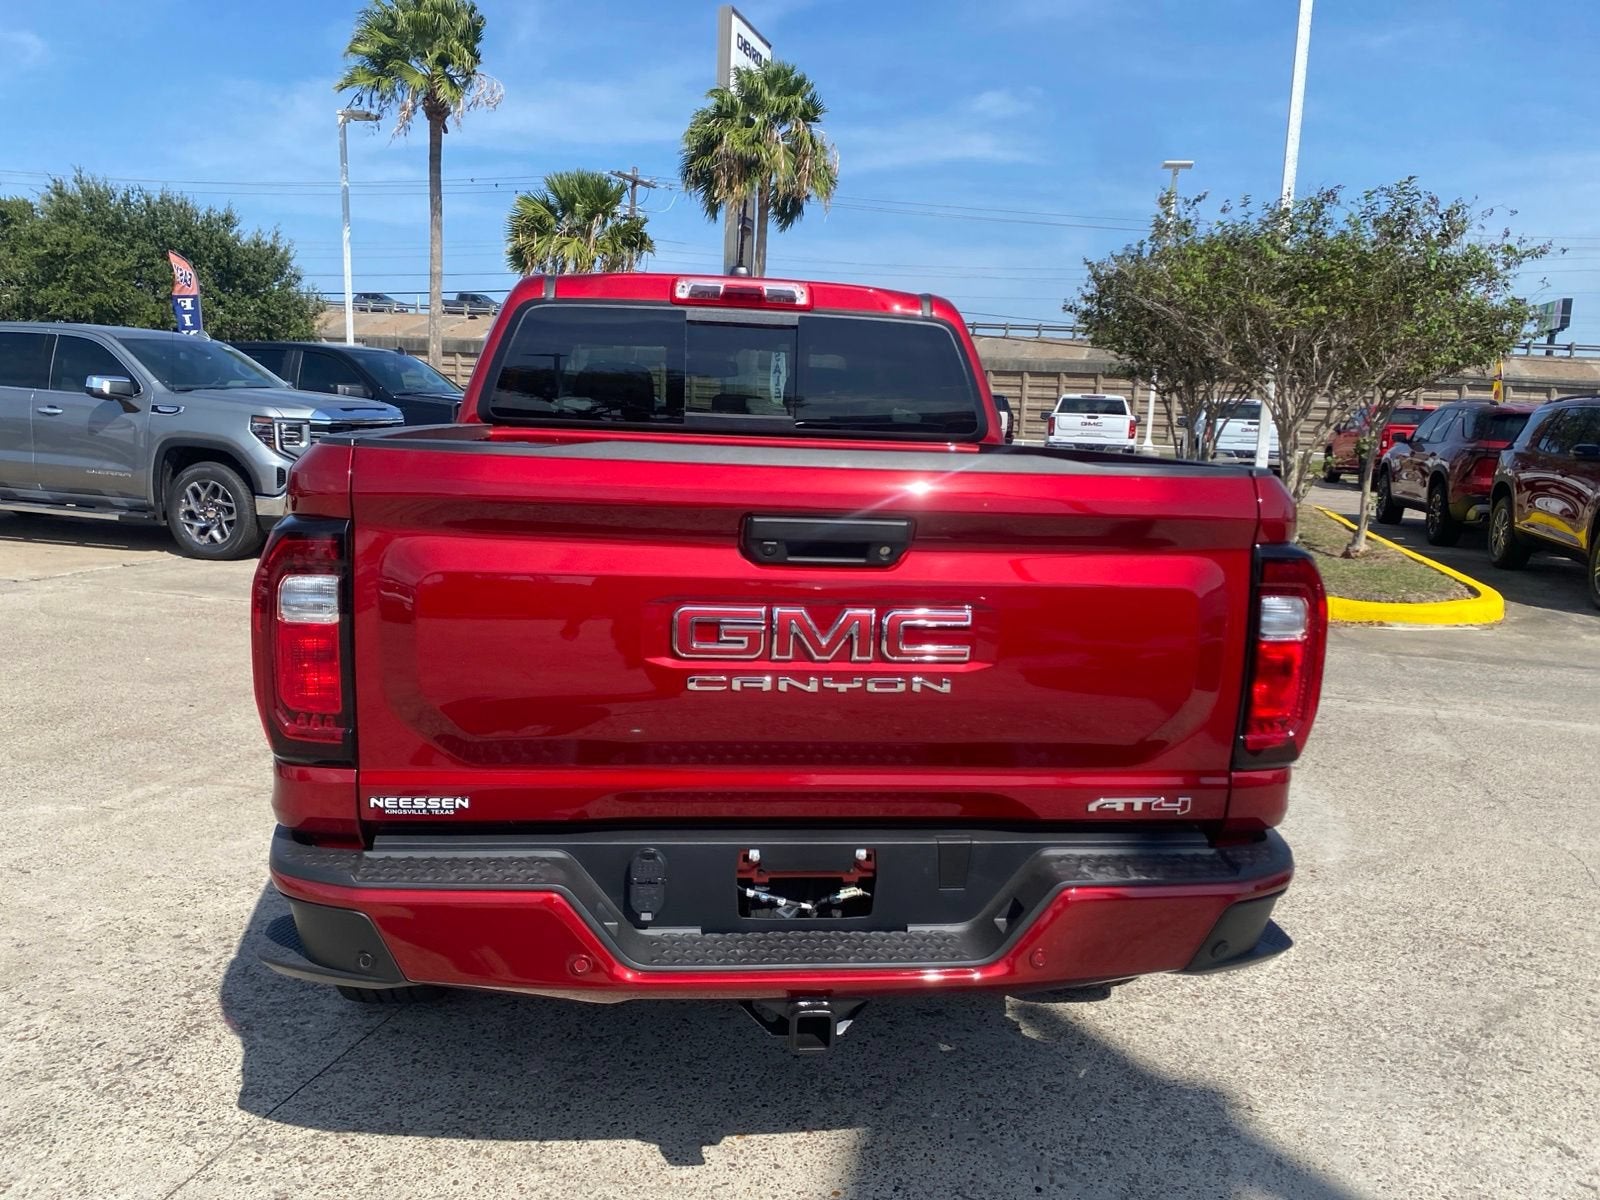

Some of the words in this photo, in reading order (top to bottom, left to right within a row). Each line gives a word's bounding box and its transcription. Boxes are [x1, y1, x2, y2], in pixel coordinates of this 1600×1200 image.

[672, 604, 972, 662] GMC
[687, 675, 951, 693] CANYON
[369, 797, 469, 809] NEESSEN
[1087, 796, 1192, 815] AT4
